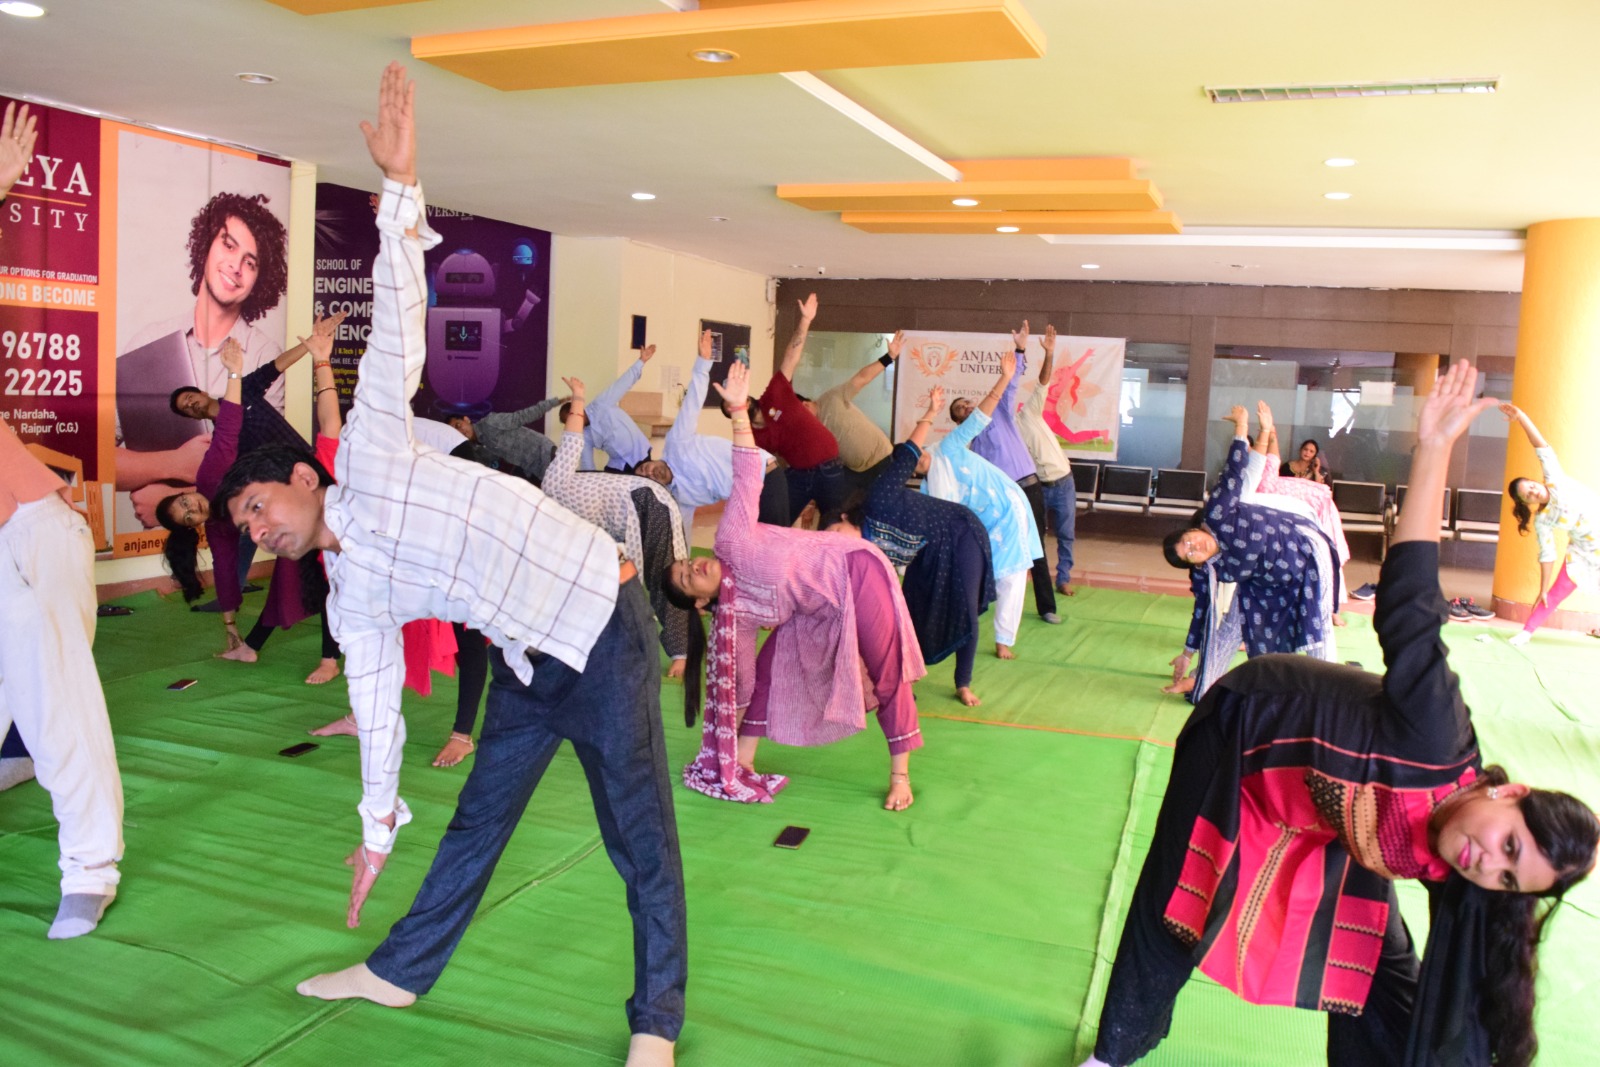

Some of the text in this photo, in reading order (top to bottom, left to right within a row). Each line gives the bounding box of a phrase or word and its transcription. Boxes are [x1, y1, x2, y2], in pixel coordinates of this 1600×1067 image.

[9, 202, 89, 232] SITY
[316, 259, 362, 270] SCHOOL OF
[10, 266, 41, 278] OPTIONS
[42, 270, 55, 279] FOR
[57, 272, 98, 283] GRADUATION
[32, 285, 96, 307] BECOME
[2, 330, 81, 361] 96788
[4, 368, 82, 396] 22225
[13, 409, 58, 420] Nardaha,
[21, 423, 52, 436] Raipur
[55, 422, 79, 434] (C.G.)
